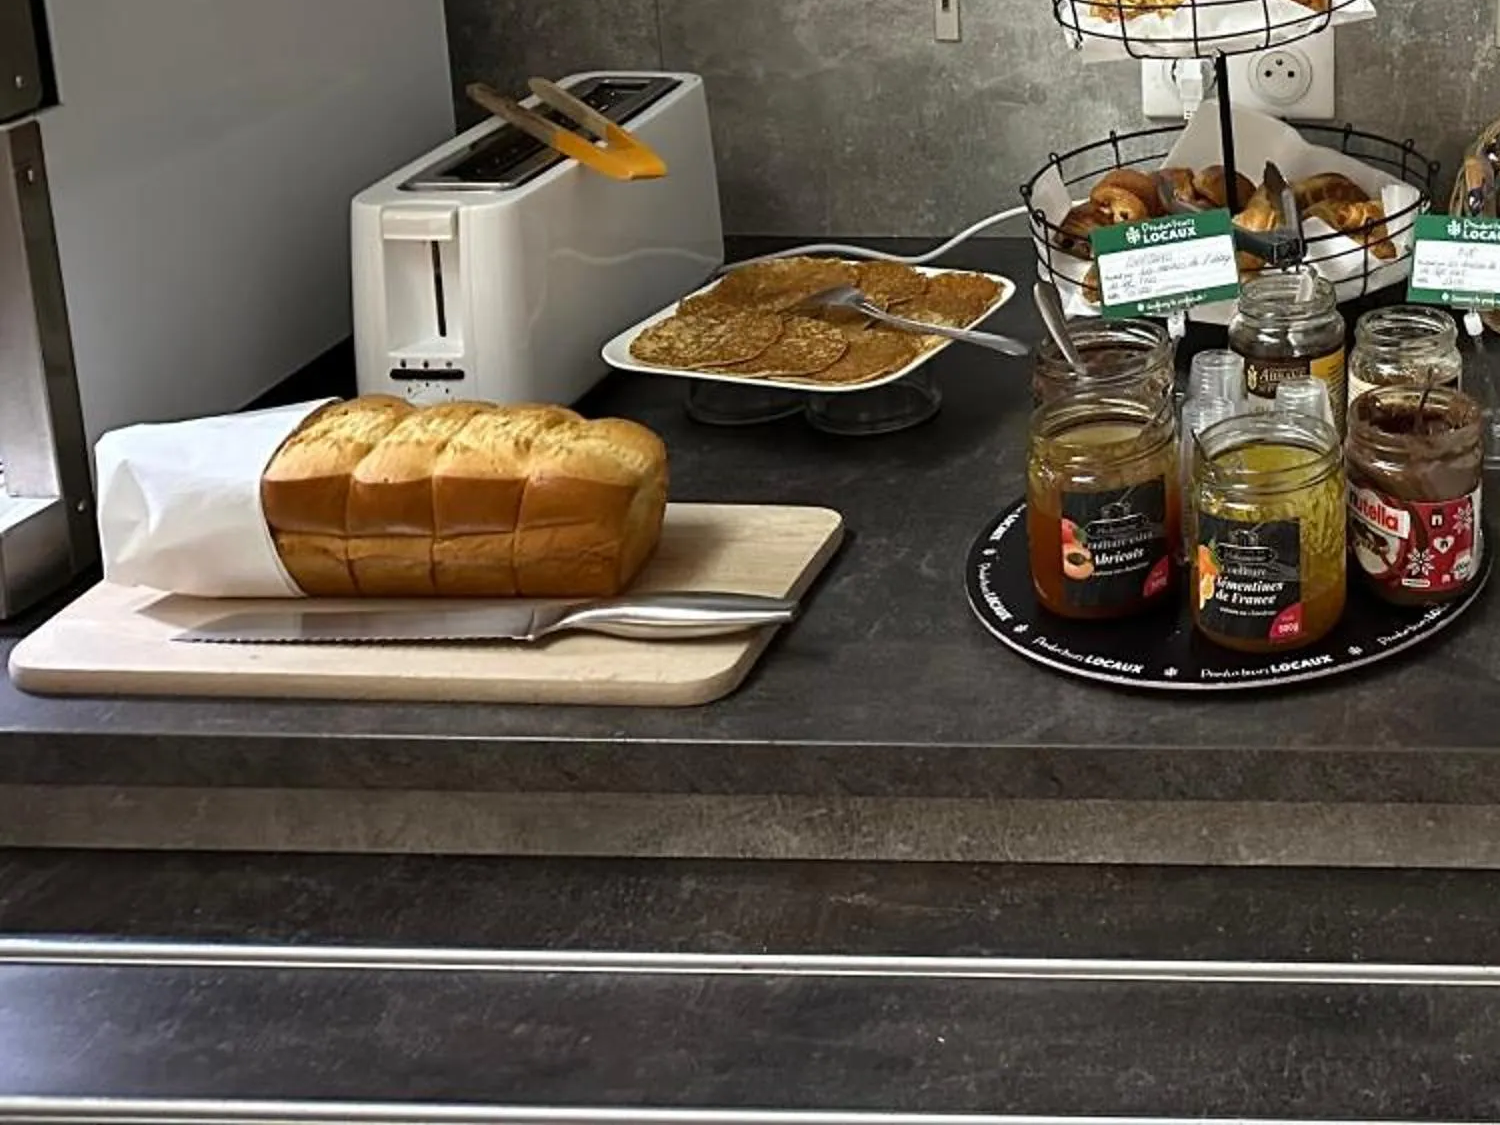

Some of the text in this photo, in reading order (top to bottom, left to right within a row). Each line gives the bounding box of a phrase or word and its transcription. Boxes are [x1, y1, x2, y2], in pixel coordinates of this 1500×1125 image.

[1142, 226, 1197, 245] LOCAUX
[1215, 589, 1278, 606] de France
[1084, 654, 1145, 674] LOCAUX
[1270, 654, 1334, 674] LOCAUX
